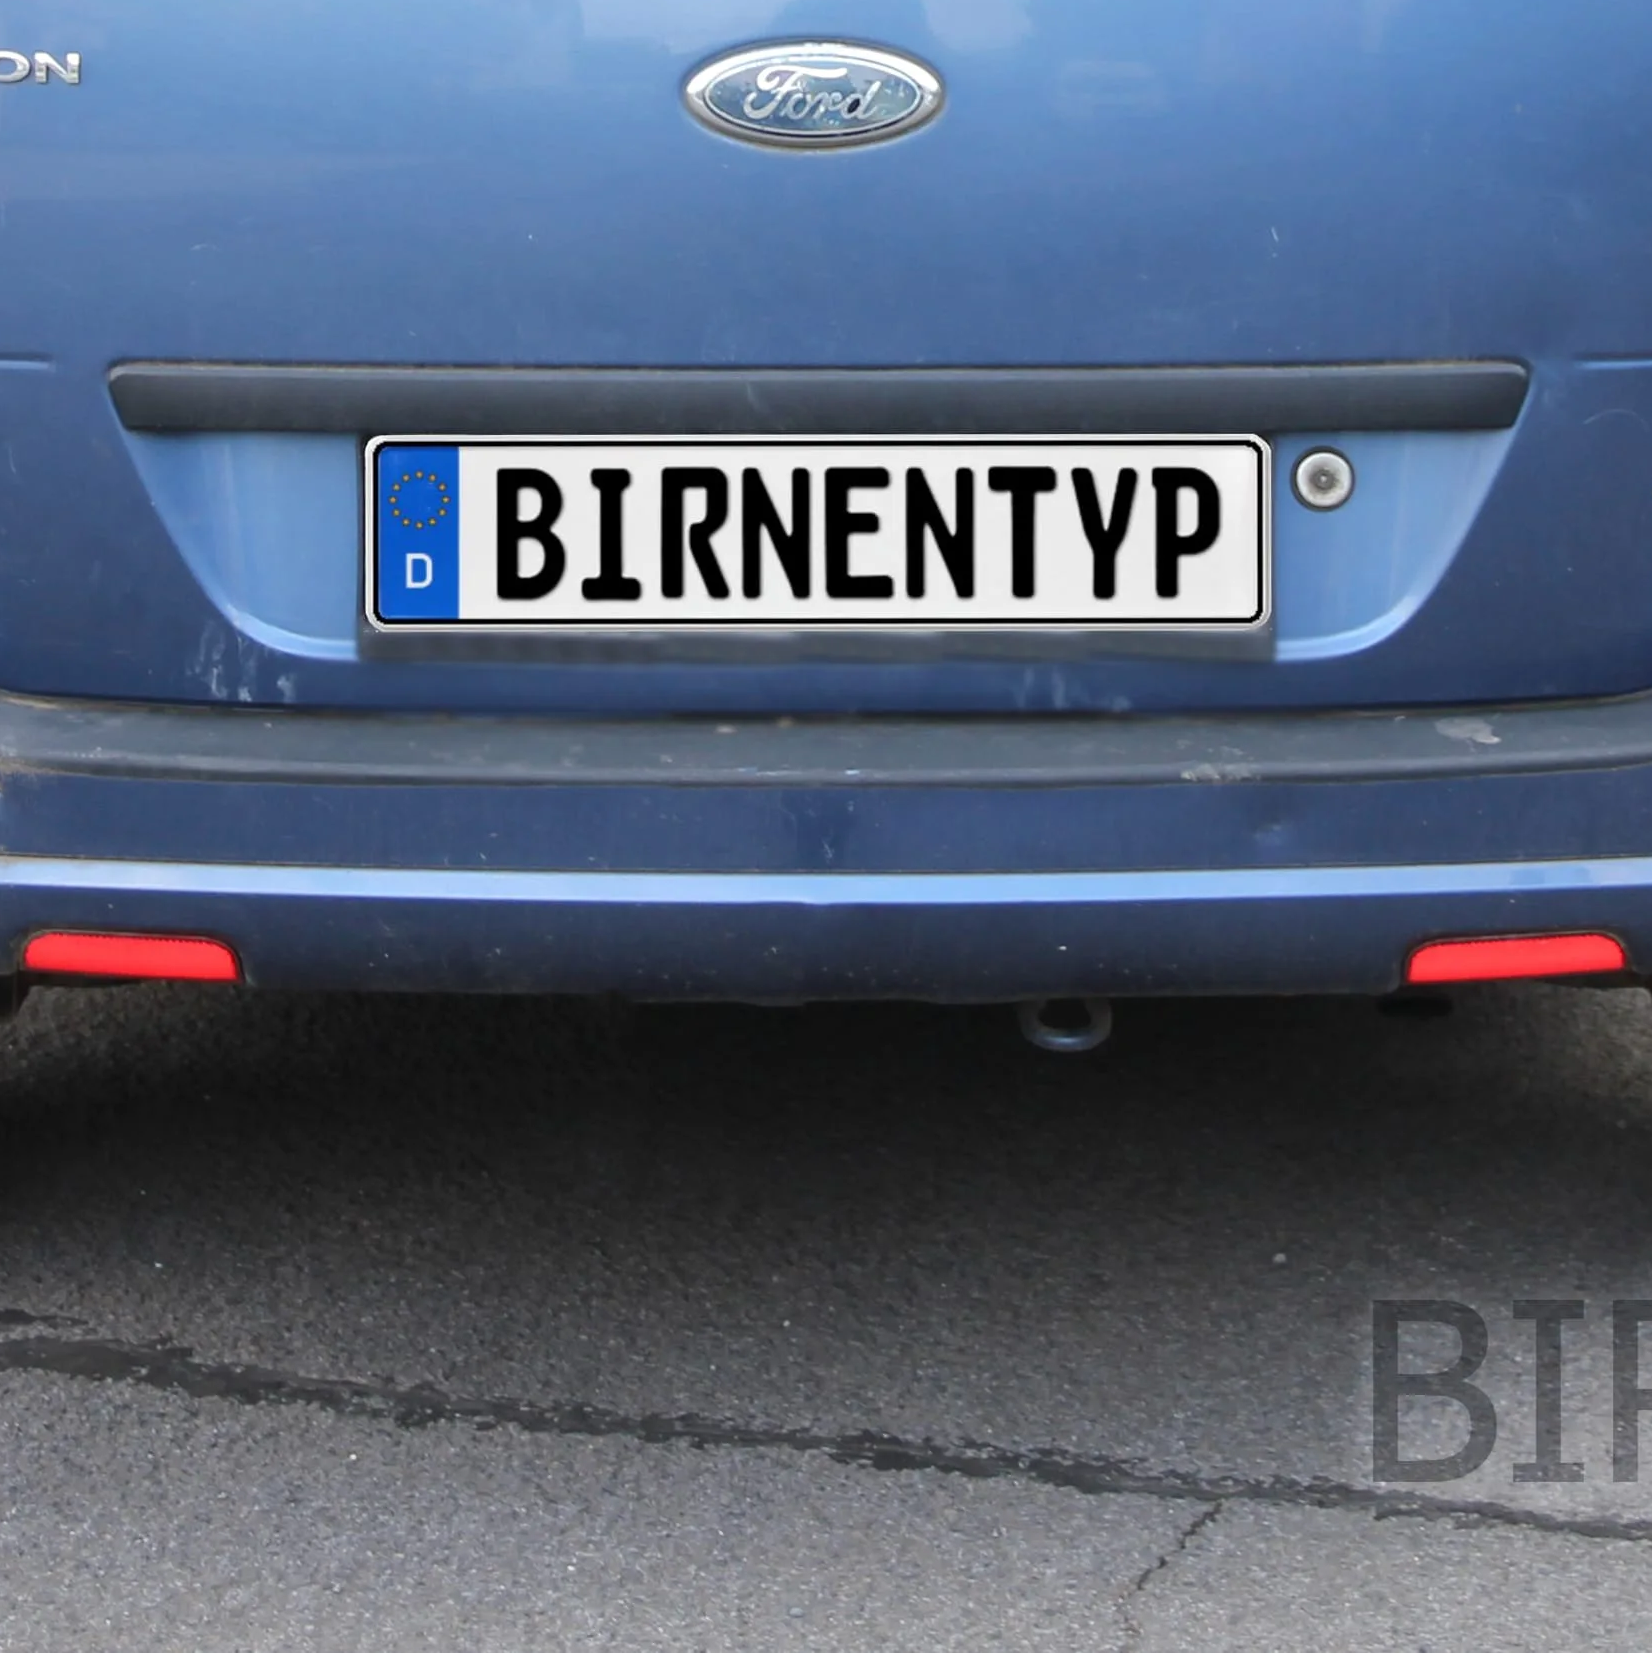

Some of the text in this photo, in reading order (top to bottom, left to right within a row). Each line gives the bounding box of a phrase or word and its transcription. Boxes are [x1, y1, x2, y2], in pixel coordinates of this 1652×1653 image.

[743, 64, 882, 121] Ford
[496, 466, 1221, 601] BIRNENTYP
[405, 552, 434, 589] D
